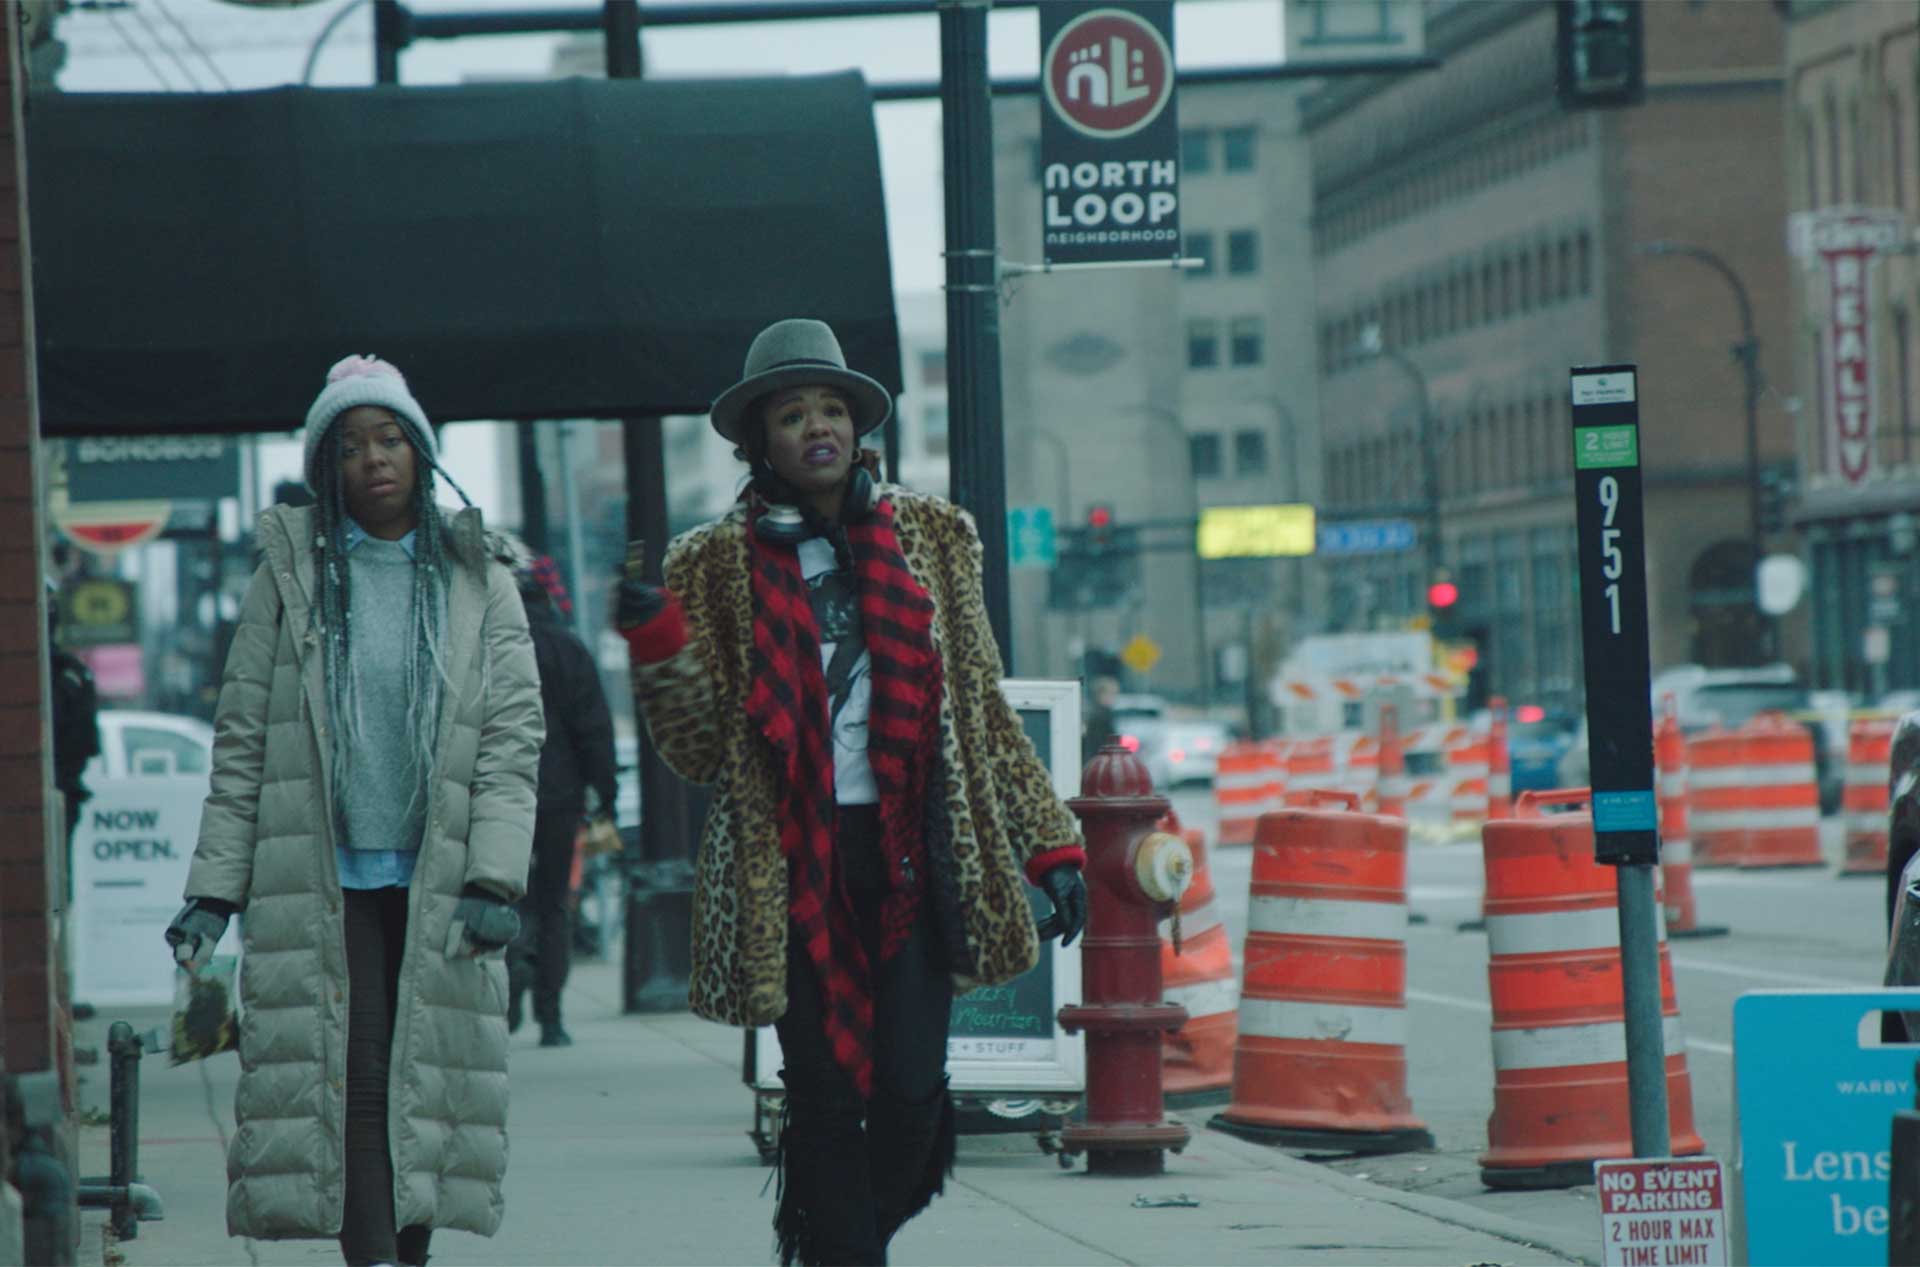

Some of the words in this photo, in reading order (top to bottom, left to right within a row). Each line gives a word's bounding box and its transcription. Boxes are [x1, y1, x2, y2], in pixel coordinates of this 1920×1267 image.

[1045, 160, 1176, 189] NORTH
[1047, 192, 1176, 226] LOOP
[1047, 229, 1177, 244] NEIGHBORHOOD
[1585, 432, 1599, 450] 2
[1599, 475, 1622, 634] 951
[93, 810, 159, 830] NOW
[93, 840, 179, 861] OPEN.
[976, 1042, 1026, 1054] STUFF
[1836, 1081, 1909, 1094] WARBY
[1602, 1172, 1636, 1191] NO
[1643, 1168, 1717, 1190] EVENT
[1611, 1190, 1712, 1211] PARKING
[1612, 1222, 1621, 1242] 2
[1629, 1220, 1672, 1241] HOUR
[1680, 1218, 1715, 1239] MAX
[1620, 1246, 1659, 1267] TIME
[1666, 1244, 1708, 1266] LIMIT
